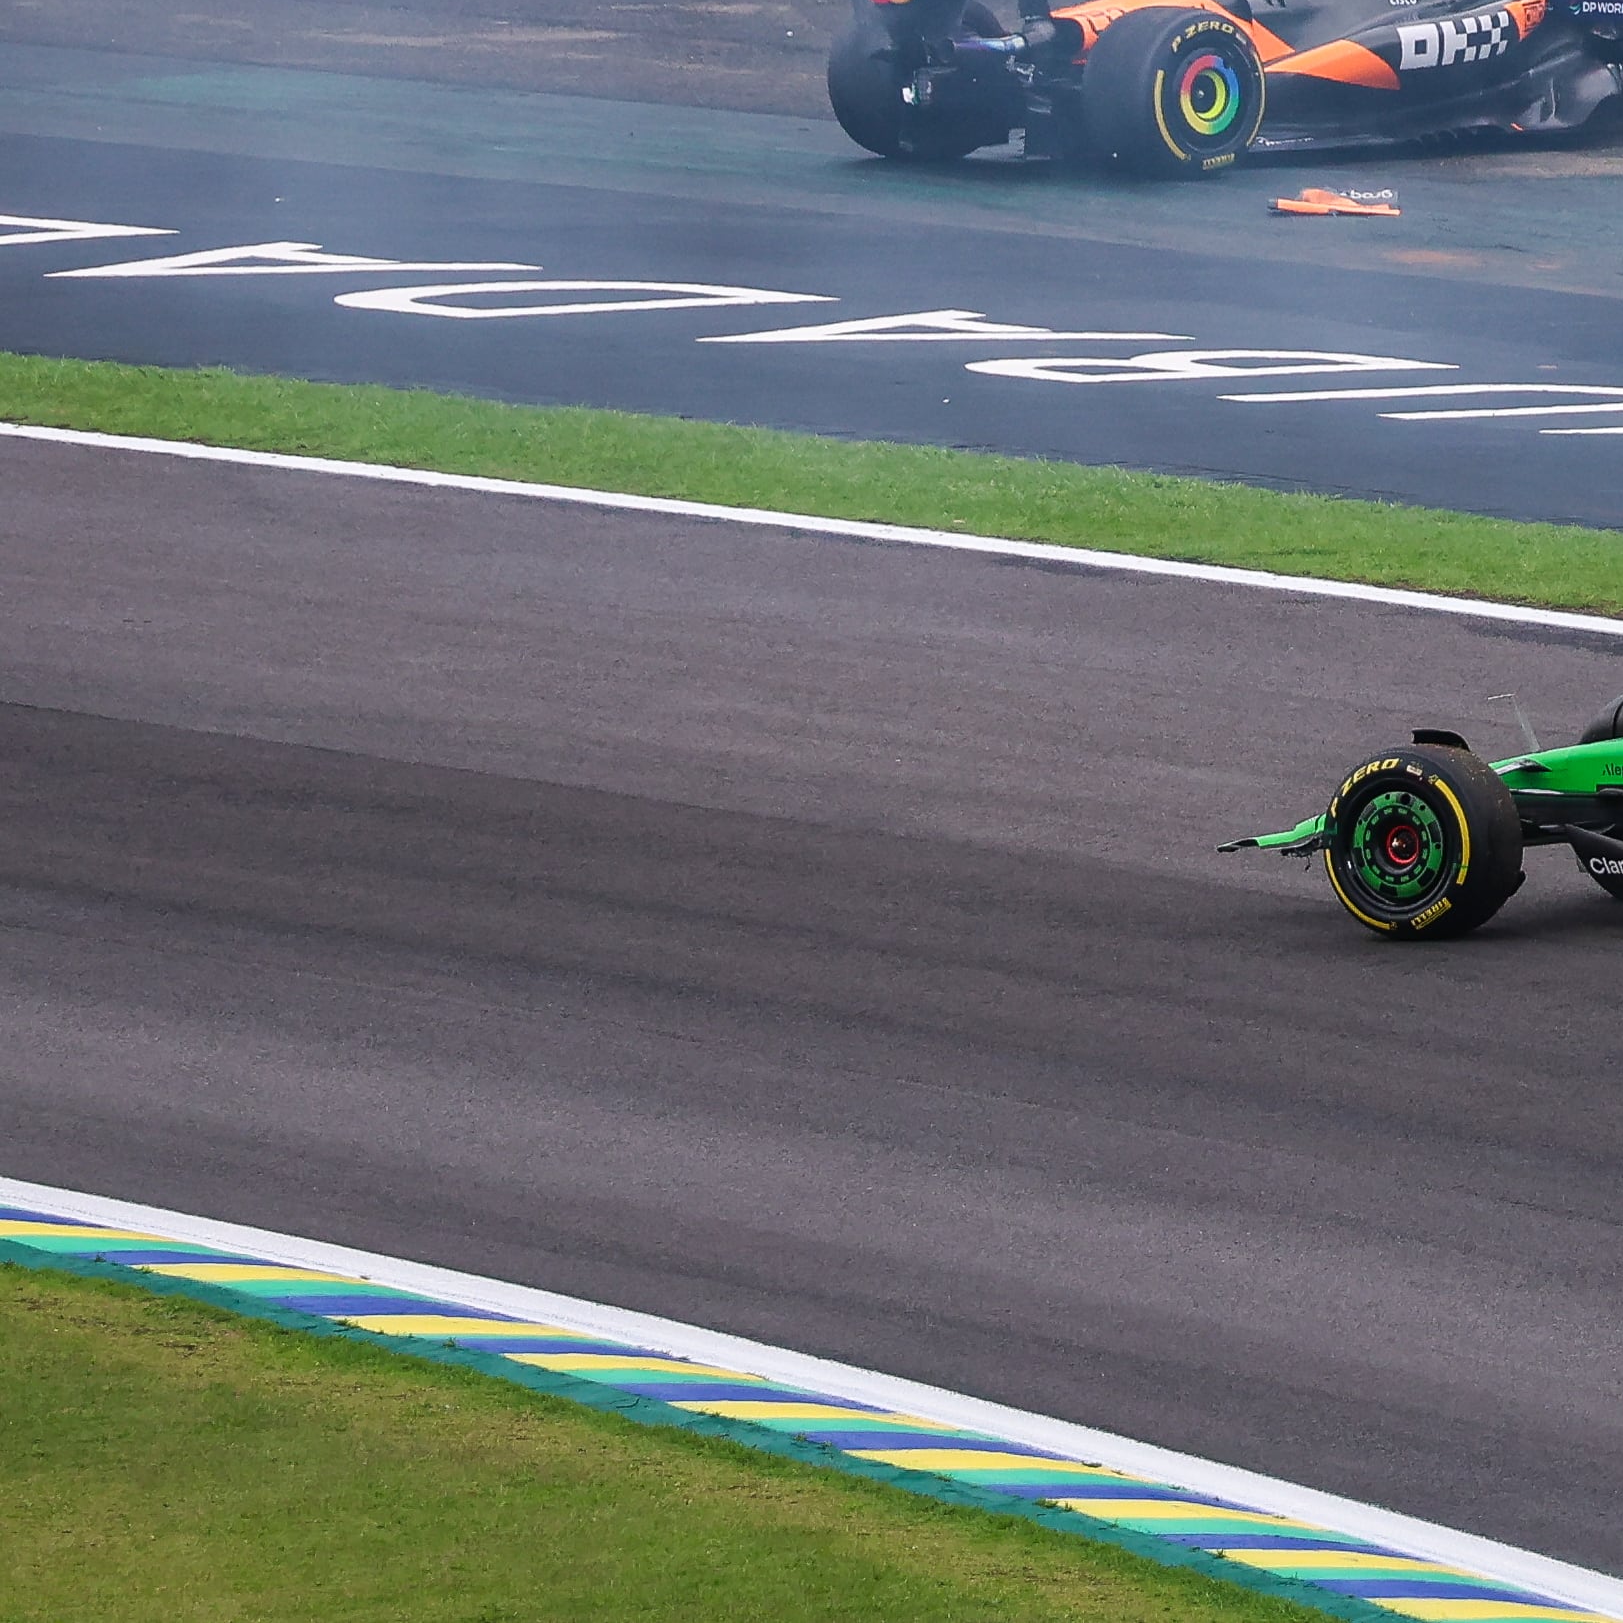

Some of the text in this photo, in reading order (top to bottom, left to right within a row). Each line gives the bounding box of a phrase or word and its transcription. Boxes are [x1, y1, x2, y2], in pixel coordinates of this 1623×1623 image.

[1582, 1, 1596, 12] DP
[1171, 21, 1235, 53] P ZERO
[1340, 757, 1400, 797] ZERO
[1411, 896, 1452, 929] PIRELLI
